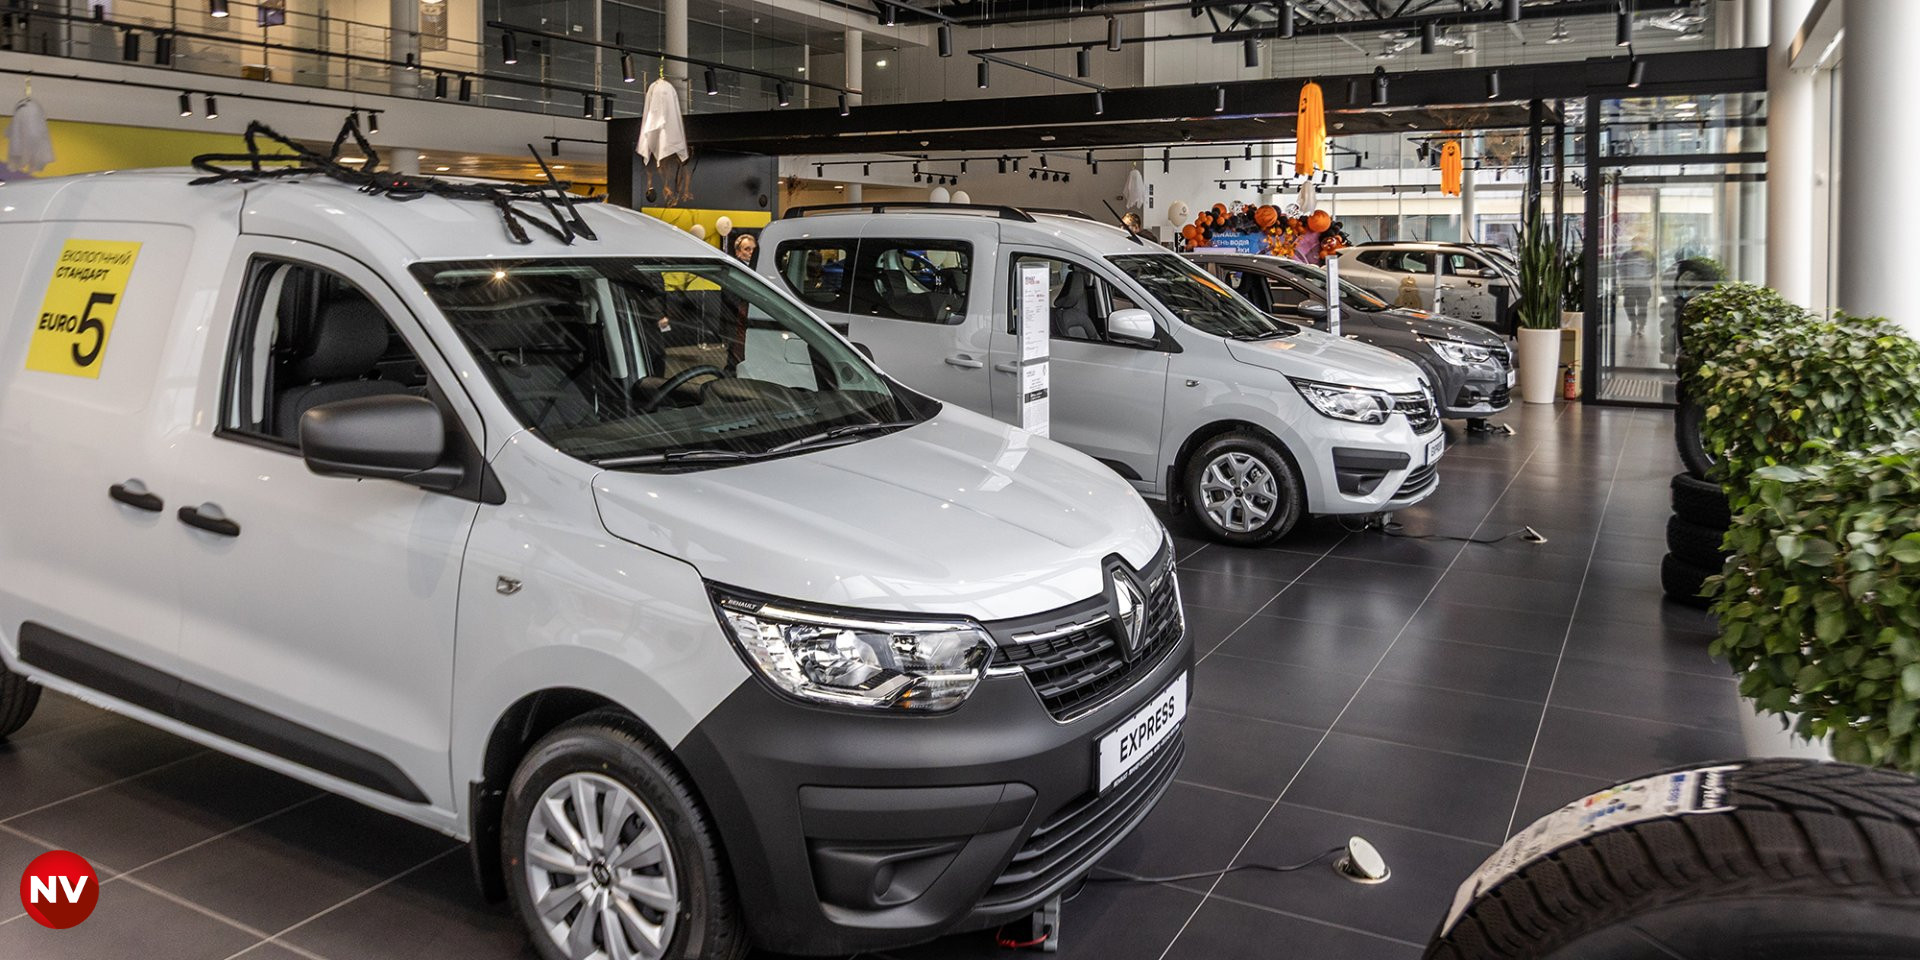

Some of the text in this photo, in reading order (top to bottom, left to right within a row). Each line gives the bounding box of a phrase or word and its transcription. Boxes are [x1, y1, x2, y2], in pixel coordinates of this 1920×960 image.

[62, 250, 132, 265] ЕКОЛОГІЧНИЙ
[56, 266, 110, 282] СТАНДАРТ
[39, 291, 117, 368] EURO 5
[728, 599, 757, 610] RENAULT
[1120, 695, 1175, 763] EXPRESS
